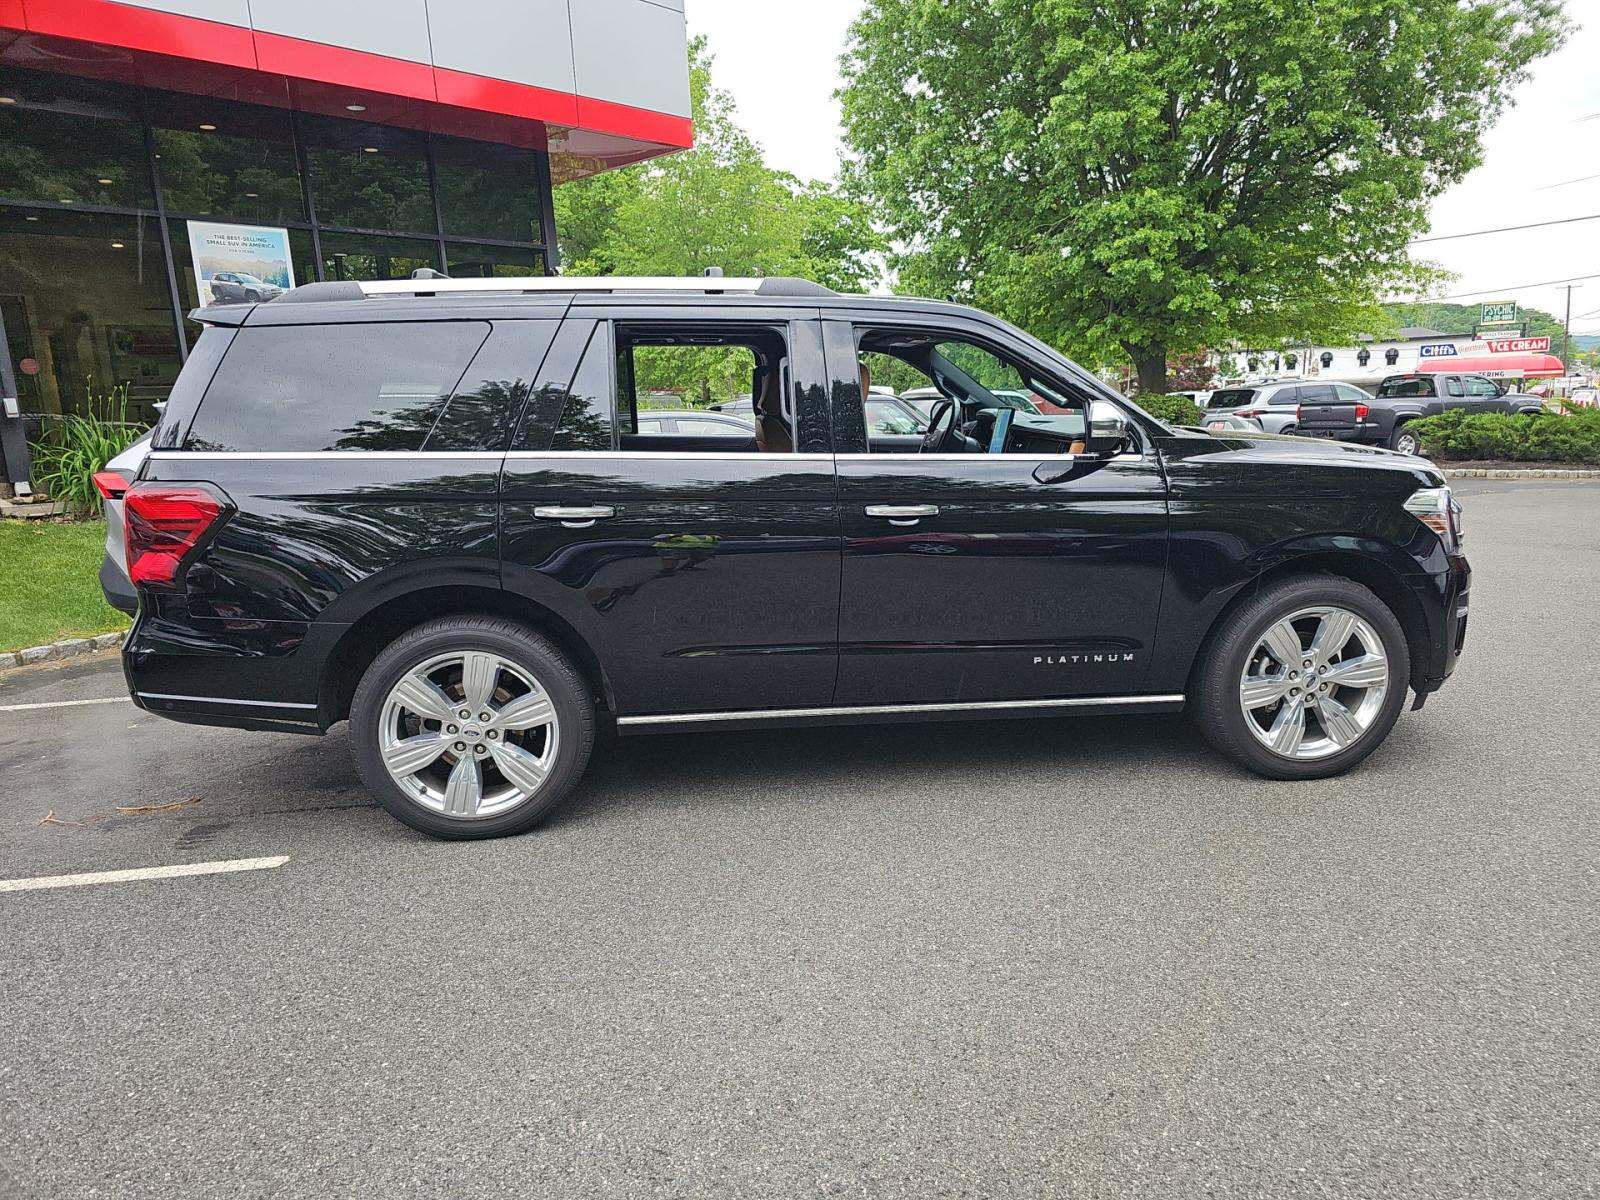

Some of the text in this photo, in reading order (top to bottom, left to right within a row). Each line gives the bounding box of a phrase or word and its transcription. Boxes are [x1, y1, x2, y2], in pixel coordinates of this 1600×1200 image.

[1484, 303, 1514, 316] PSYCHIC
[1511, 339, 1547, 351] CREAM
[1033, 653, 1134, 664] PLATINUM
